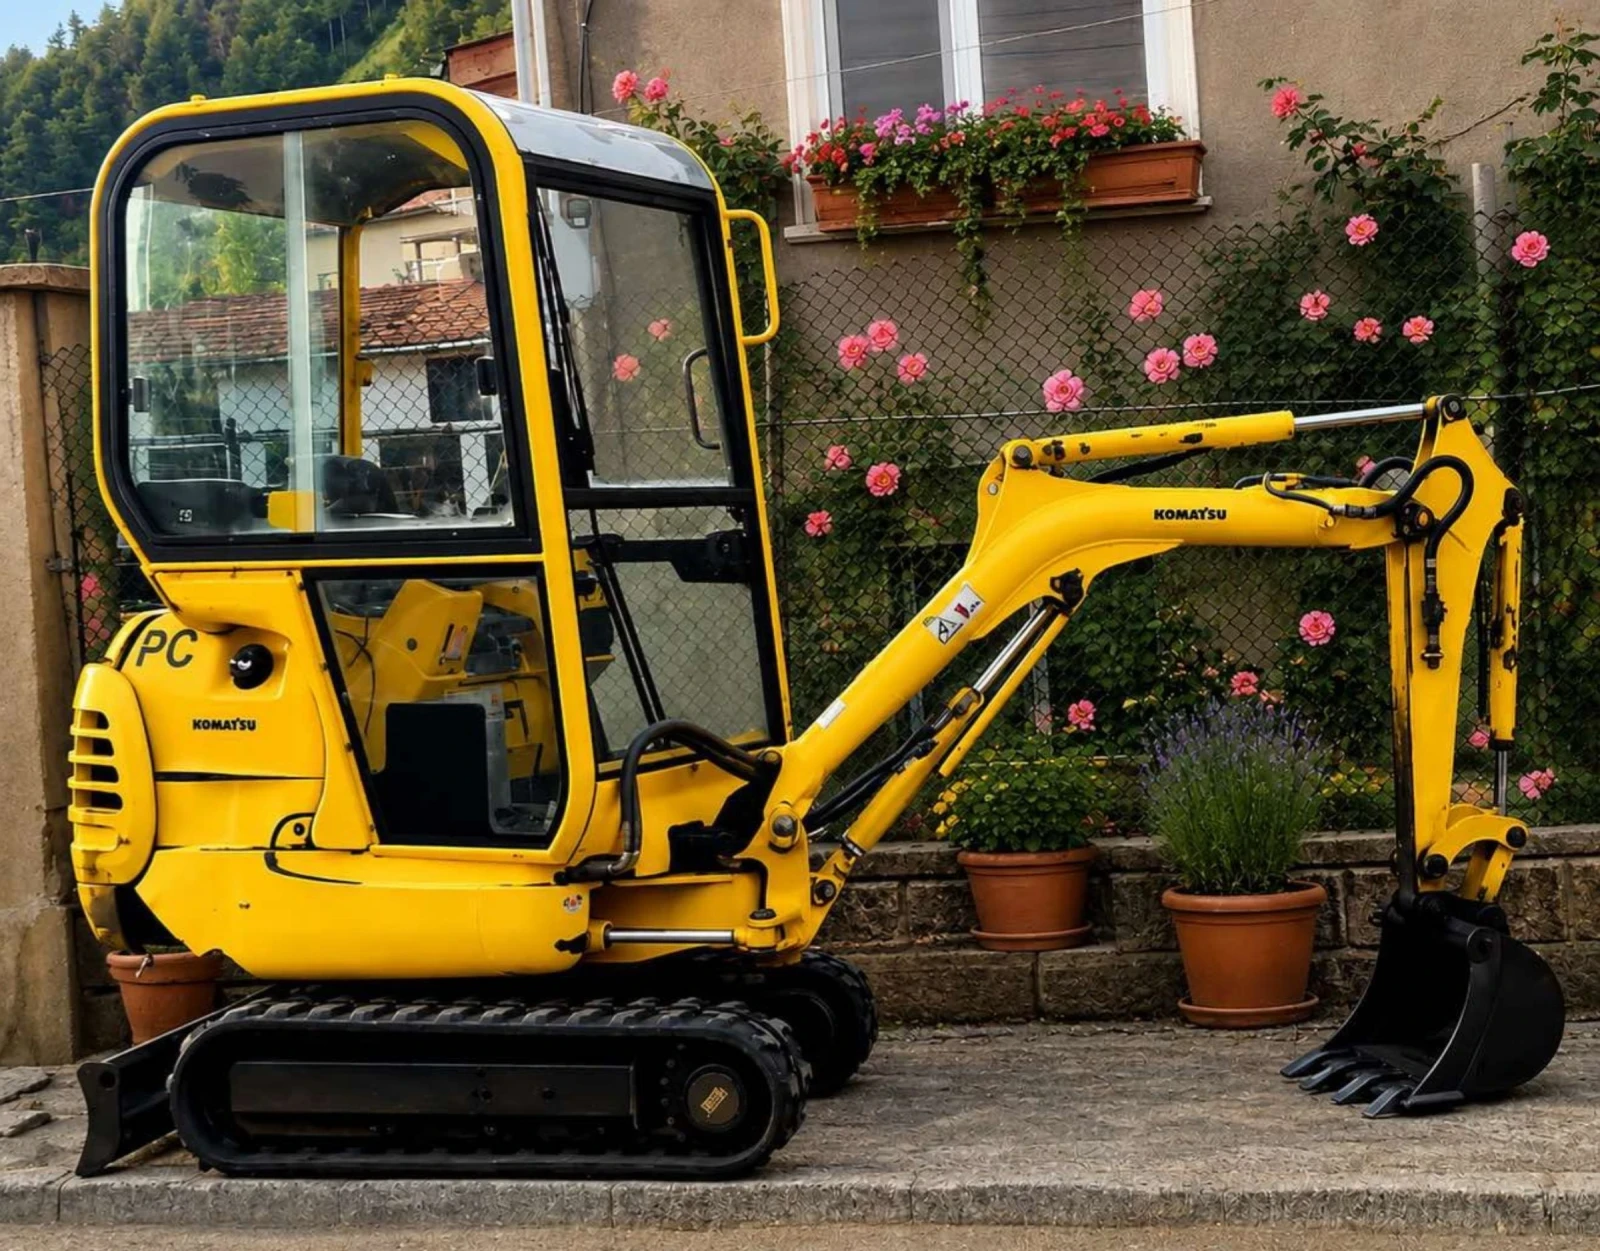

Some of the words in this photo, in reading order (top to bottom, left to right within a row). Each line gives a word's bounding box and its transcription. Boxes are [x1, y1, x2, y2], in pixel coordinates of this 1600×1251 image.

[1153, 507, 1227, 520] KOMATSU
[136, 628, 198, 668] PC
[192, 717, 257, 731] KOMATSU
